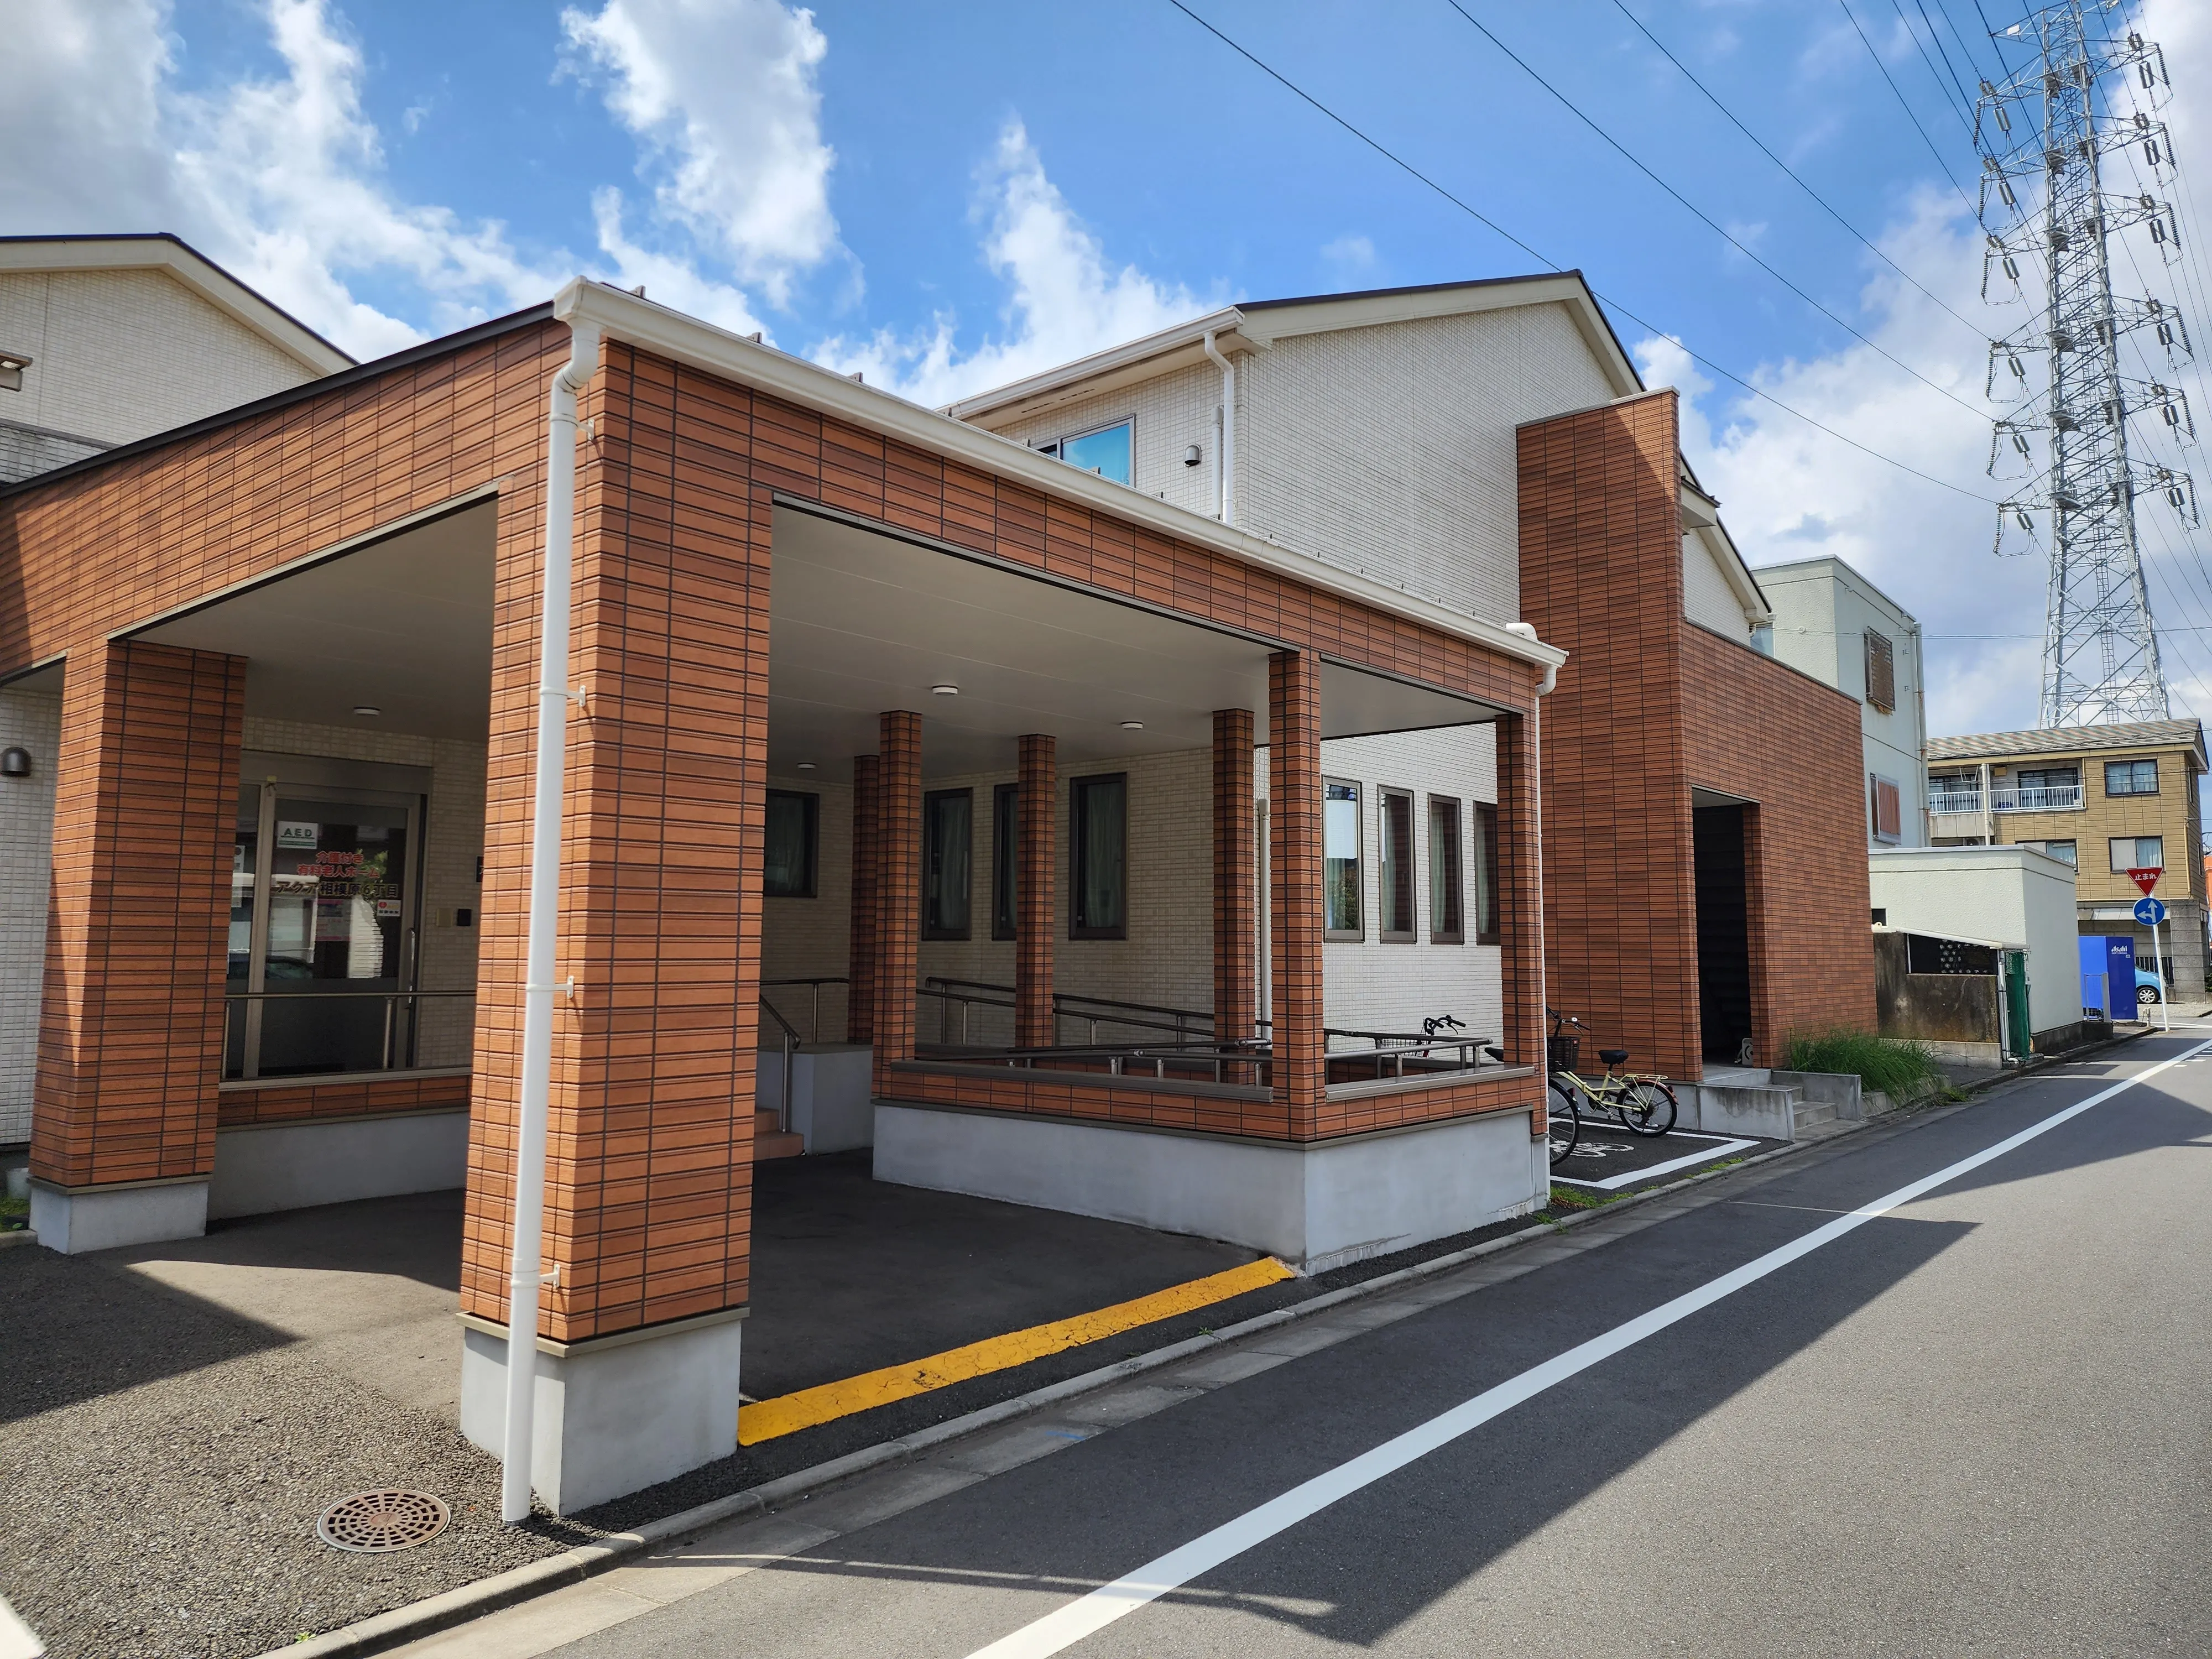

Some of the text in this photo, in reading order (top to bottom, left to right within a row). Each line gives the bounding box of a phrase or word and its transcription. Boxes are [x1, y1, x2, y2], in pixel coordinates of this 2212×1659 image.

[284, 828, 312, 836] AED
[316, 851, 364, 864] 介護付き
[298, 864, 380, 878] 有料老人ホーム
